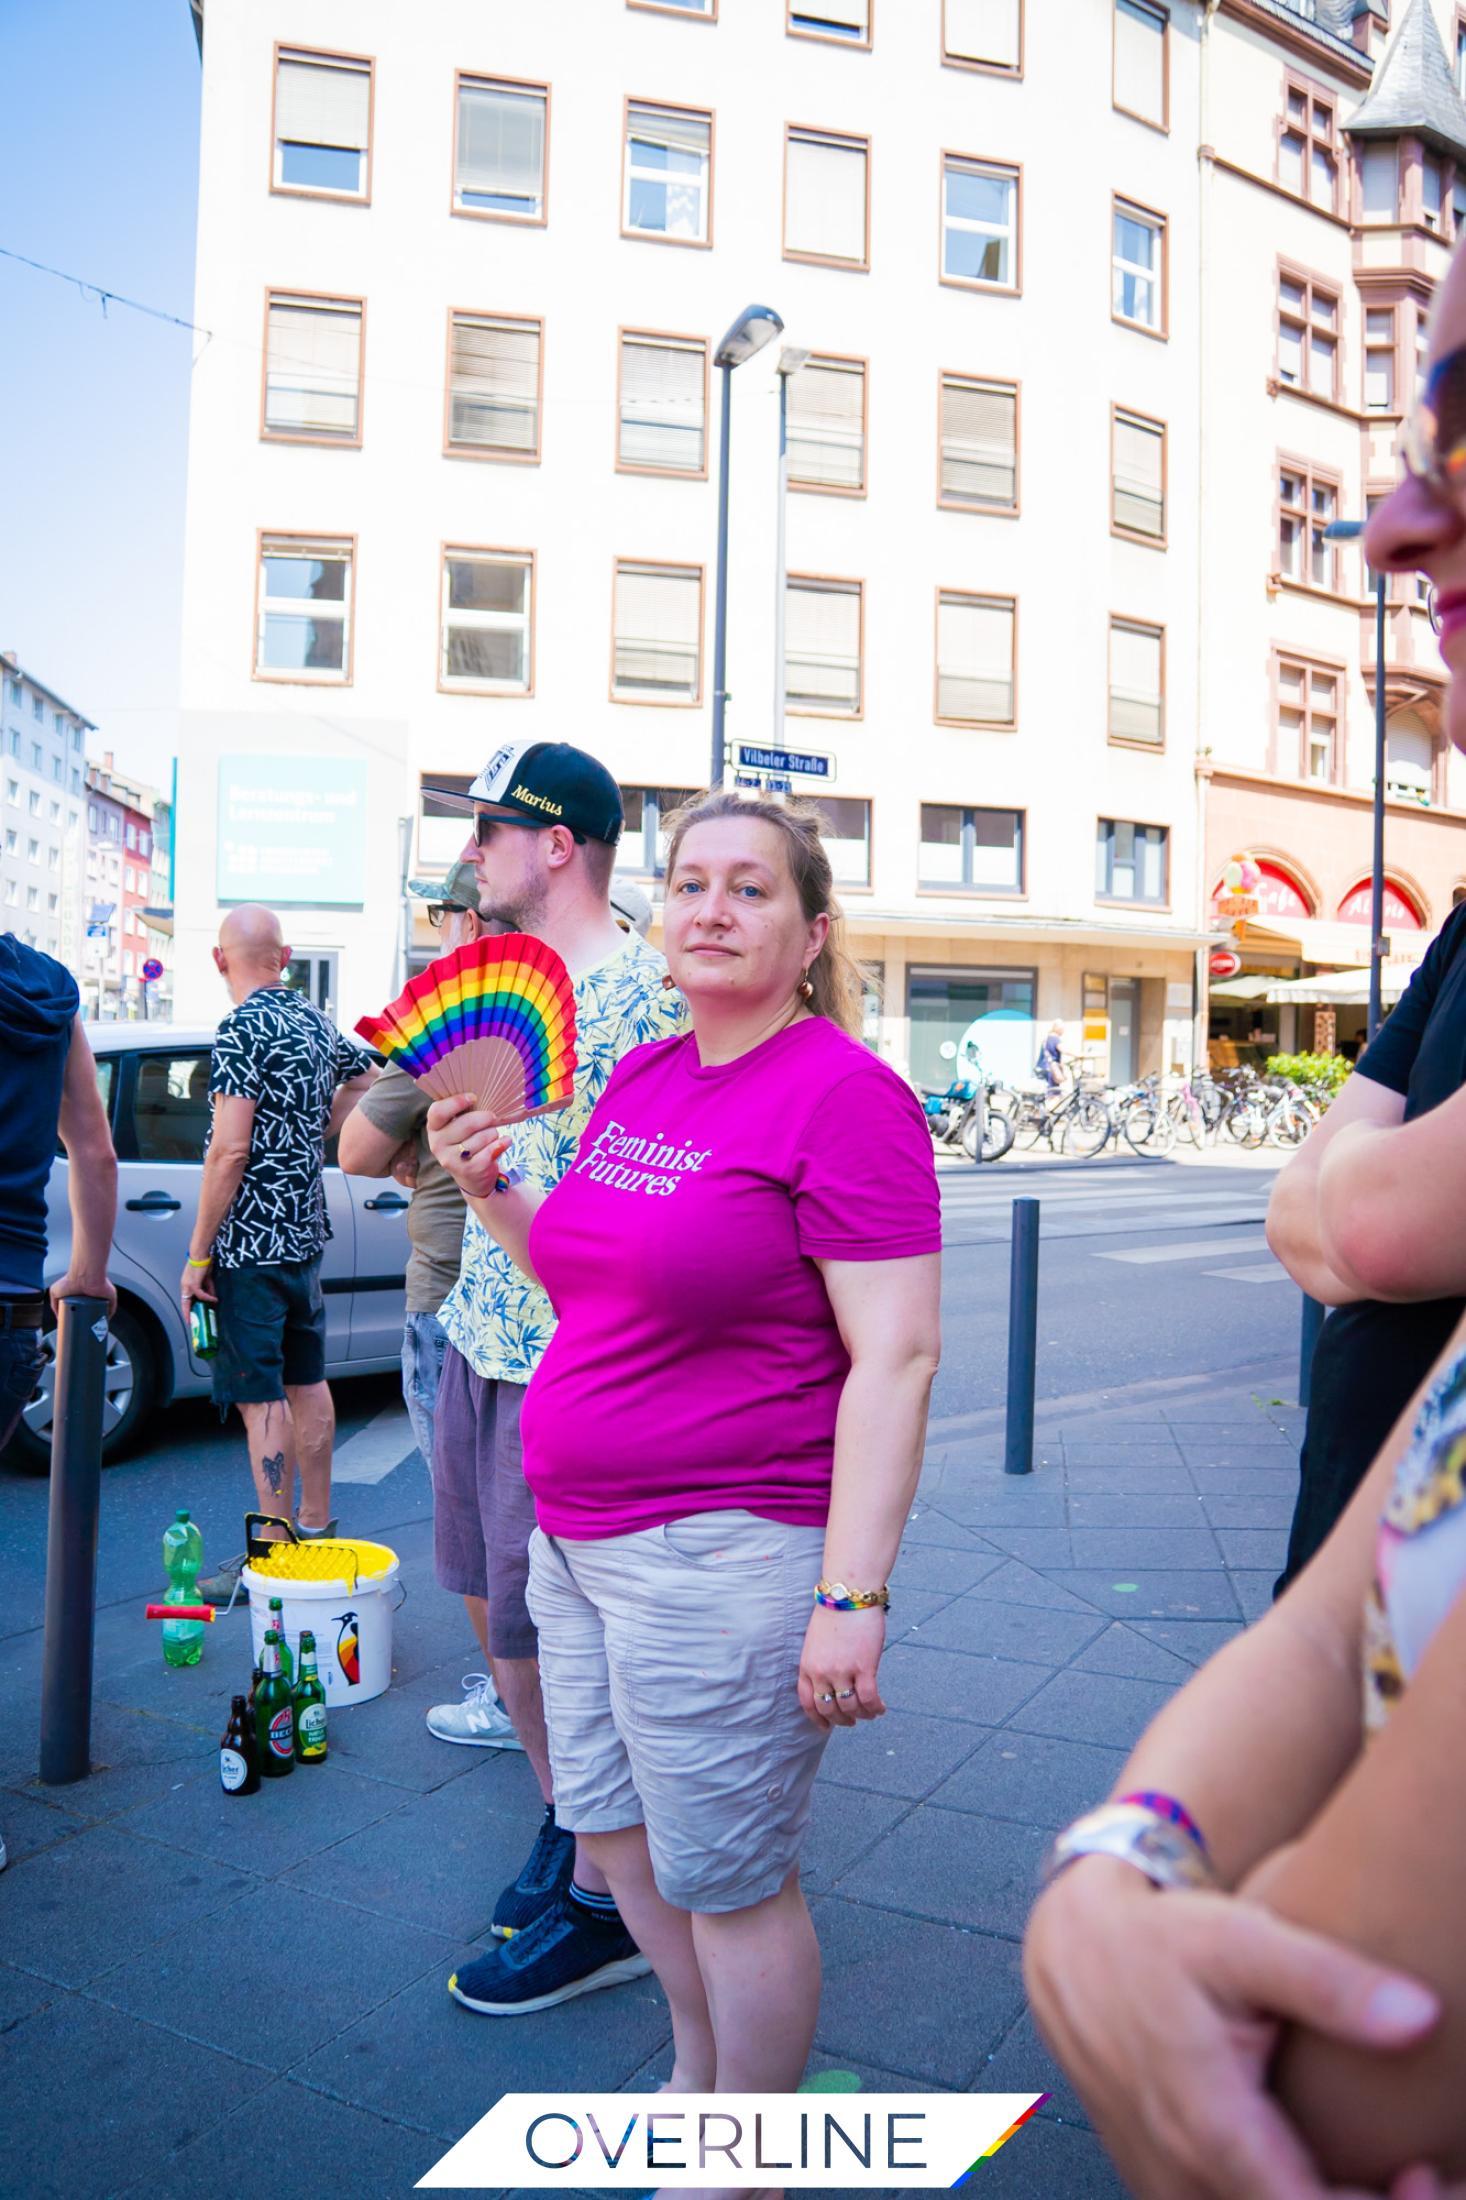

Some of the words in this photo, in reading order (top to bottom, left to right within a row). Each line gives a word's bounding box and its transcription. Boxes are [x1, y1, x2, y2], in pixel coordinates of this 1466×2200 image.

[743, 747, 785, 768] Vilbeler
[787, 754, 824, 773] Straße
[511, 784, 563, 816] Marius
[590, 1120, 713, 1172] Feminist
[574, 1148, 682, 1196] Futures
